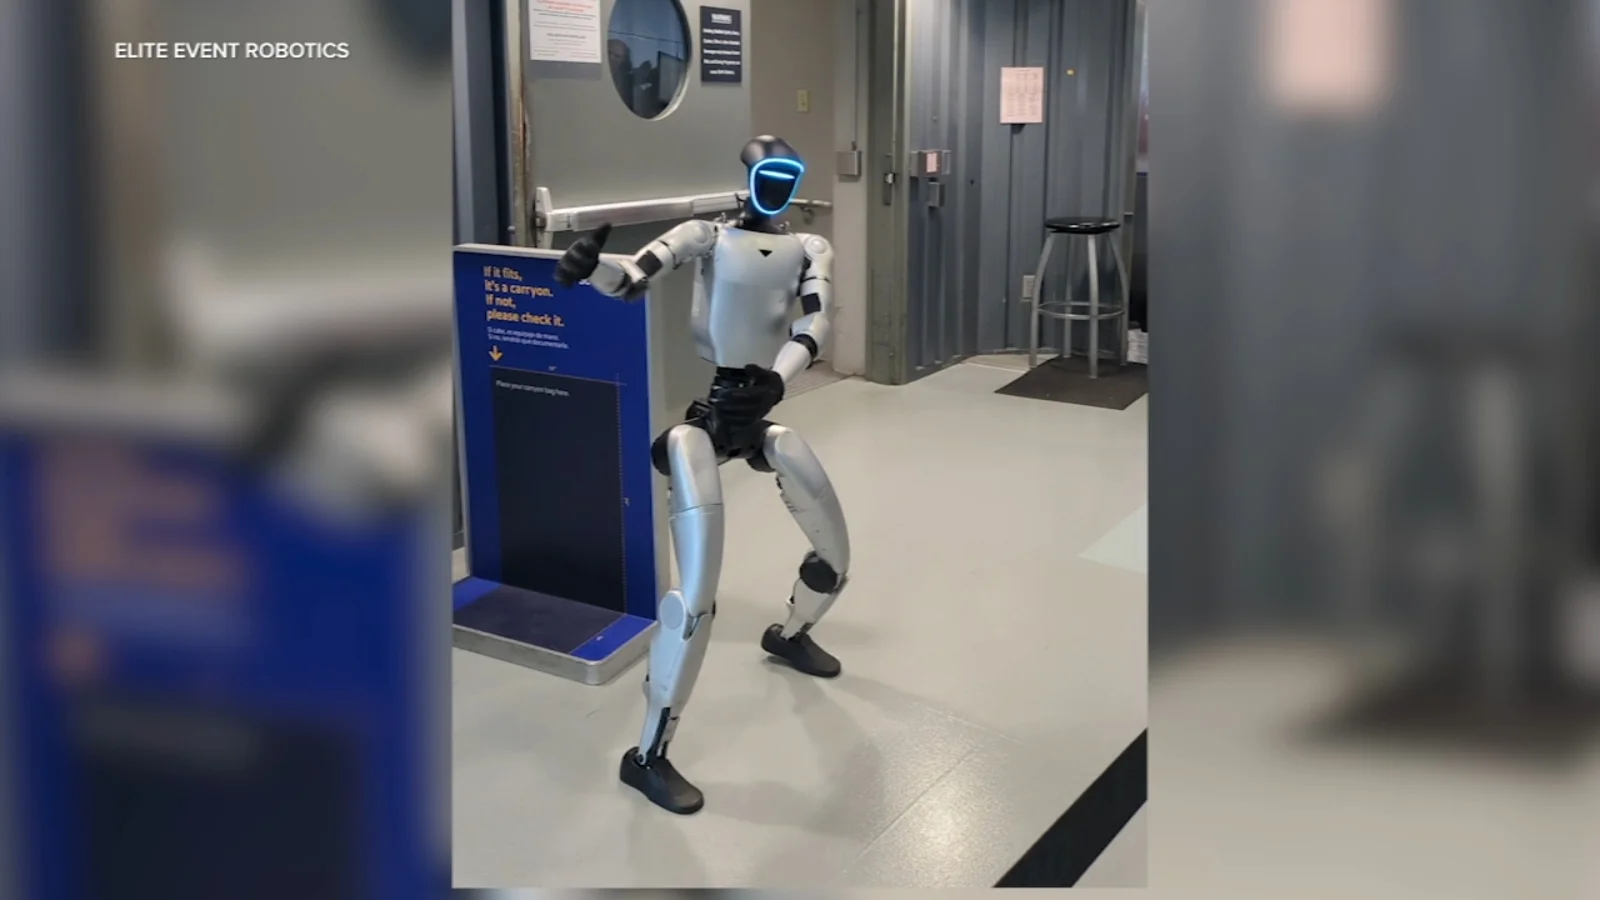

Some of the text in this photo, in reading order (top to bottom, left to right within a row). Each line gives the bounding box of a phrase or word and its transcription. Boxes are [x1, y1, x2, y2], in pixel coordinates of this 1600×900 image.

[483, 265, 523, 281] If it fits,
[501, 283, 508, 293] a
[510, 285, 554, 298] carryon.
[485, 294, 516, 309] If not,
[487, 309, 565, 327] please check it.
